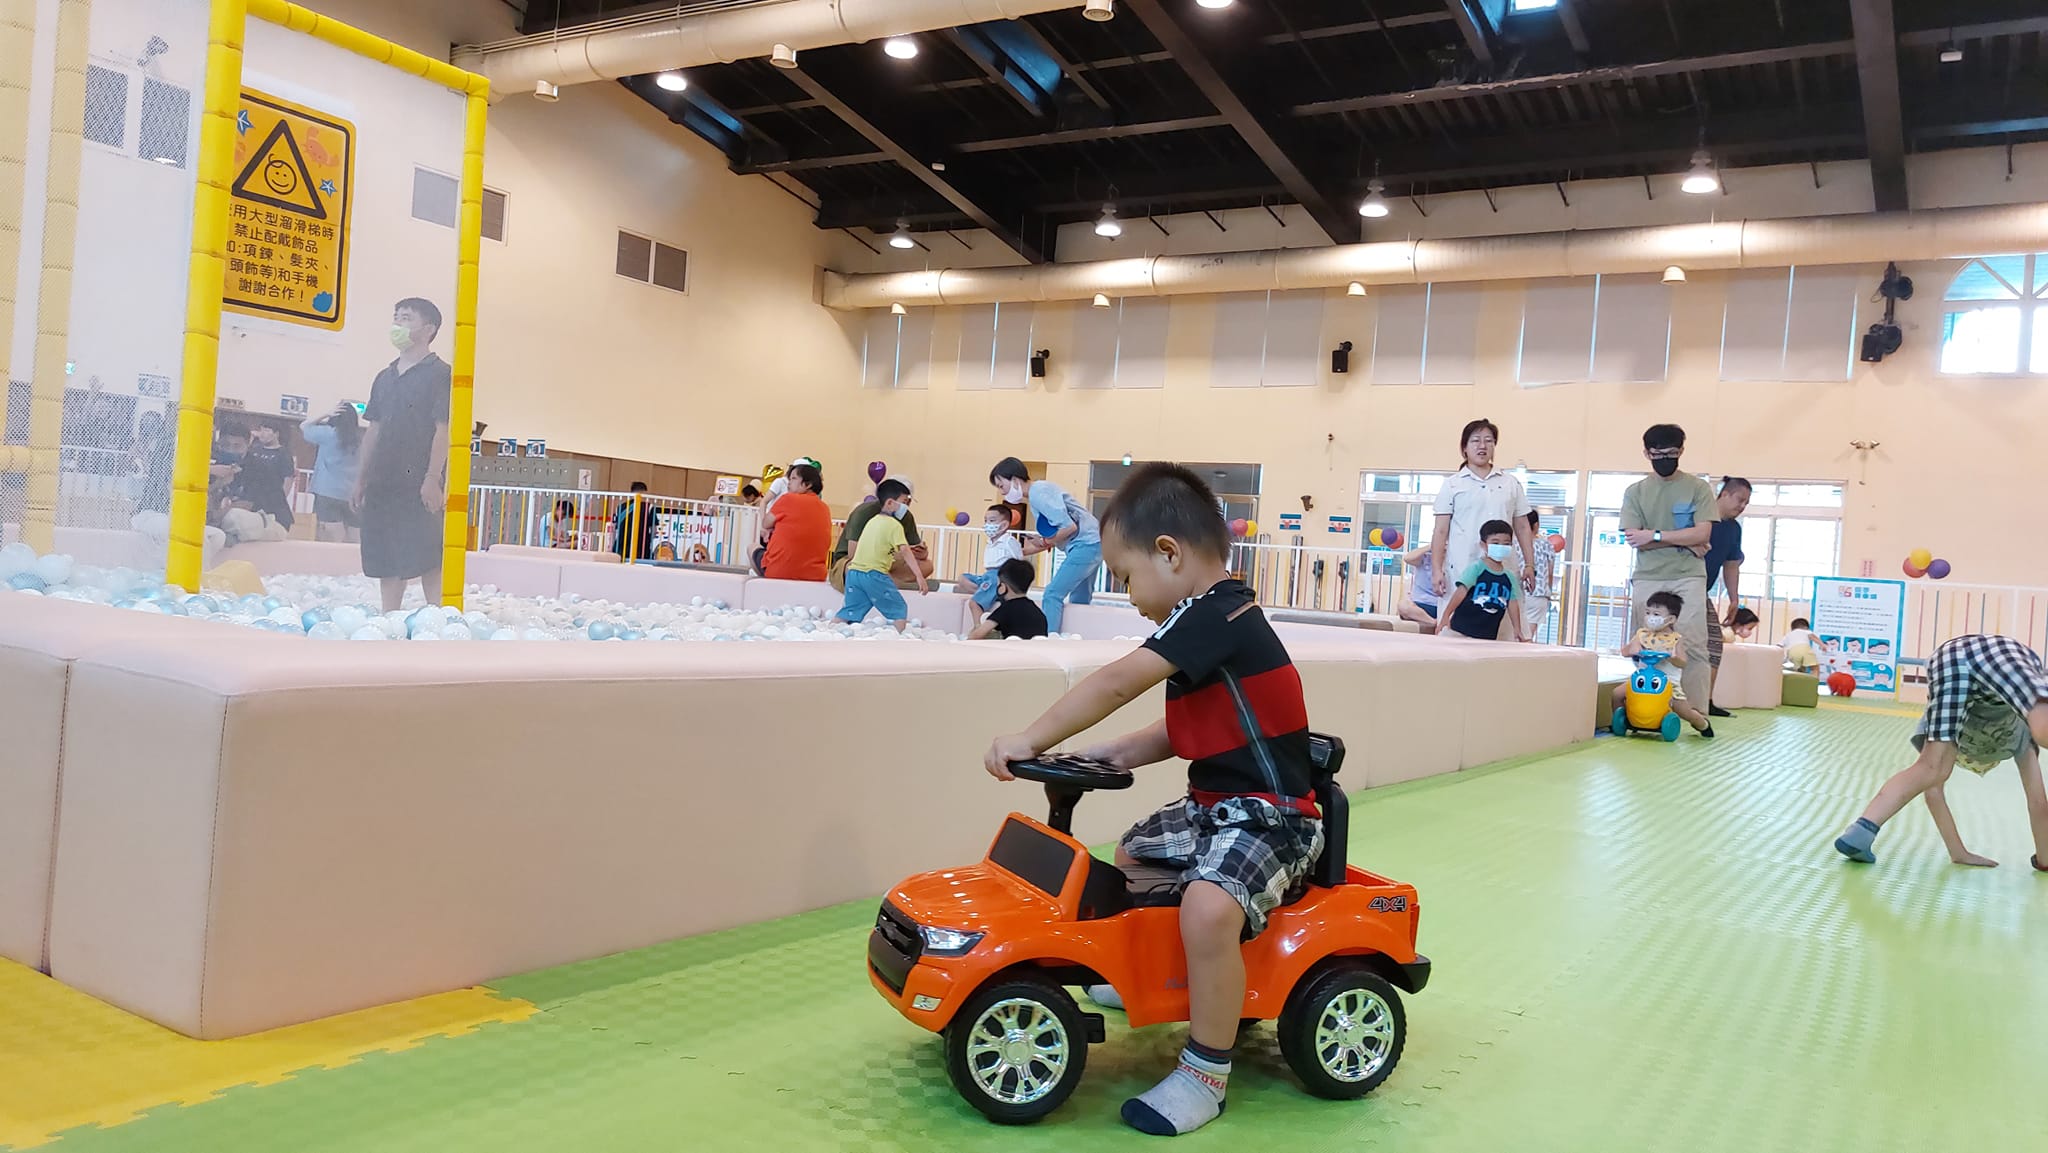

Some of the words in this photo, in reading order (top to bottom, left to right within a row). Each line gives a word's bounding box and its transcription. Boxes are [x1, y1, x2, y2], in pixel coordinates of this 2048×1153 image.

[229, 204, 334, 240] 用大型溜滑梯時
[234, 223, 318, 254] 禁止配戴飾品
[230, 258, 318, 288] 頭飾等)和手機
[239, 277, 303, 303] 謝謝合作！
